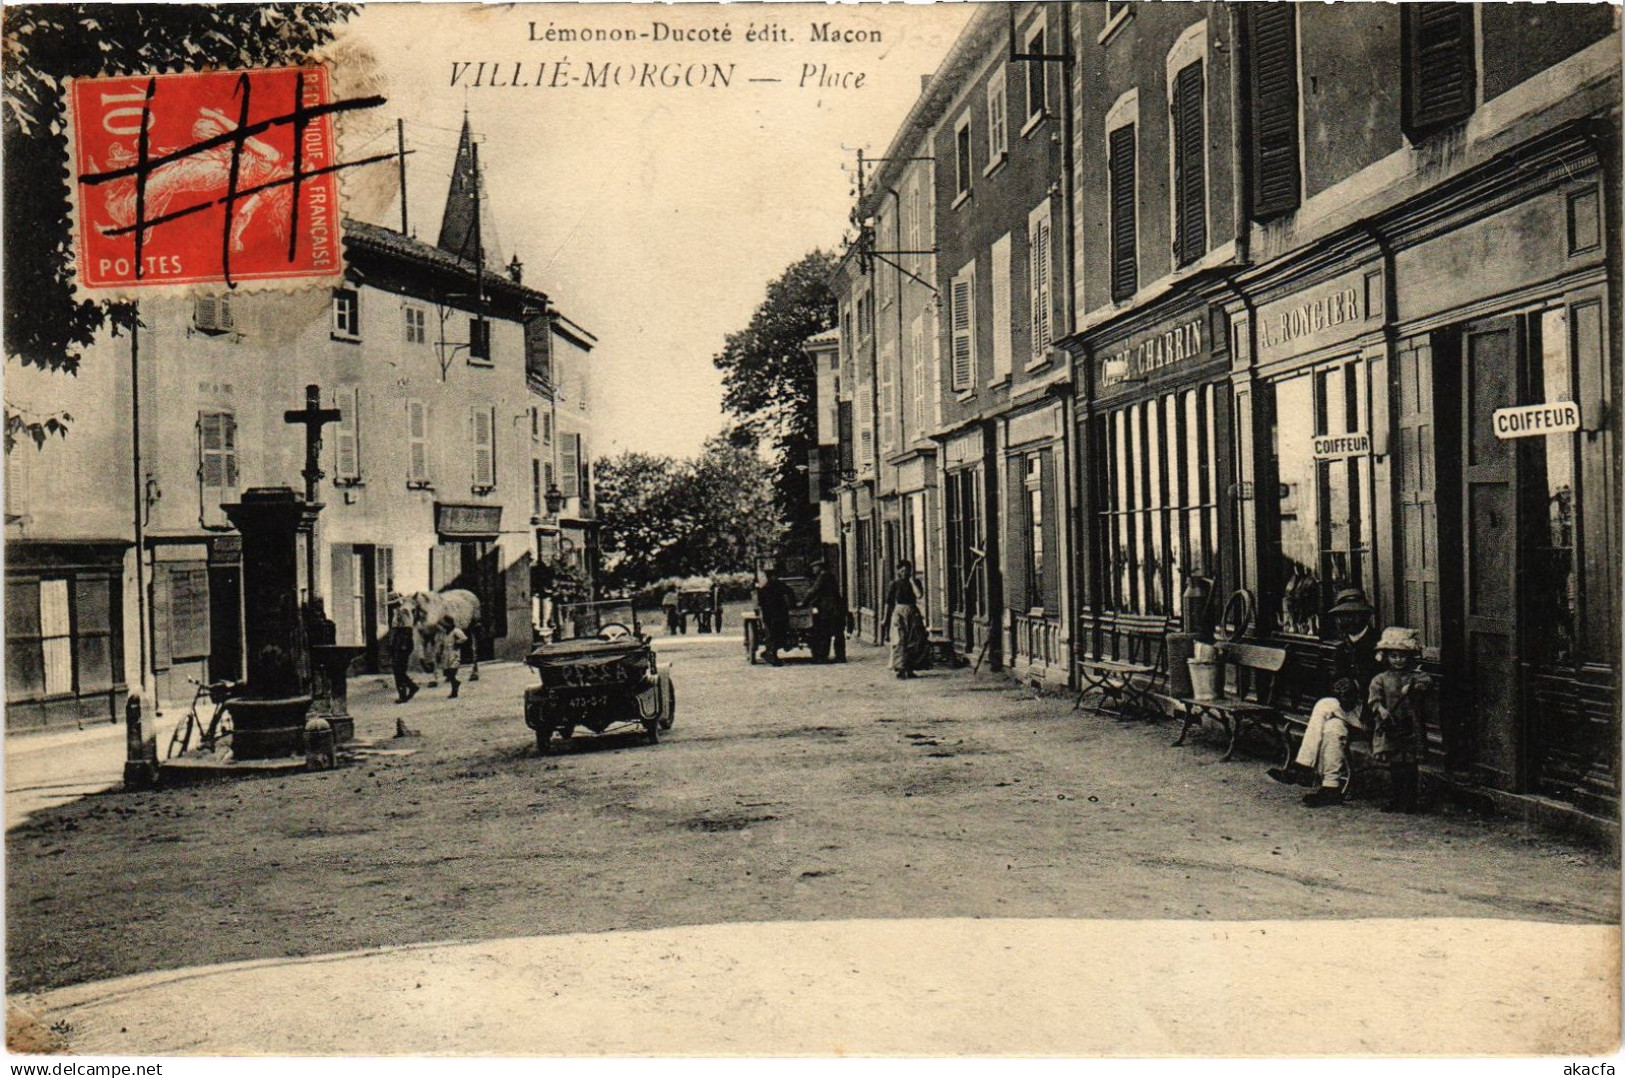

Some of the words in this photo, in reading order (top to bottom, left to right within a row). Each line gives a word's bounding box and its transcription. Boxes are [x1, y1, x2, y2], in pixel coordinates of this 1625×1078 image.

[101, 84, 155, 135] 10
[303, 74, 324, 160] REPIQUE
[309, 185, 330, 267] FRANÇAISE
[100, 255, 182, 277] POTES
[1280, 288, 1359, 343] RONGIER
[1138, 319, 1202, 374] CHARRIN
[1314, 436, 1370, 455] COIFFEUR
[1498, 407, 1576, 433] COIFFEUR
